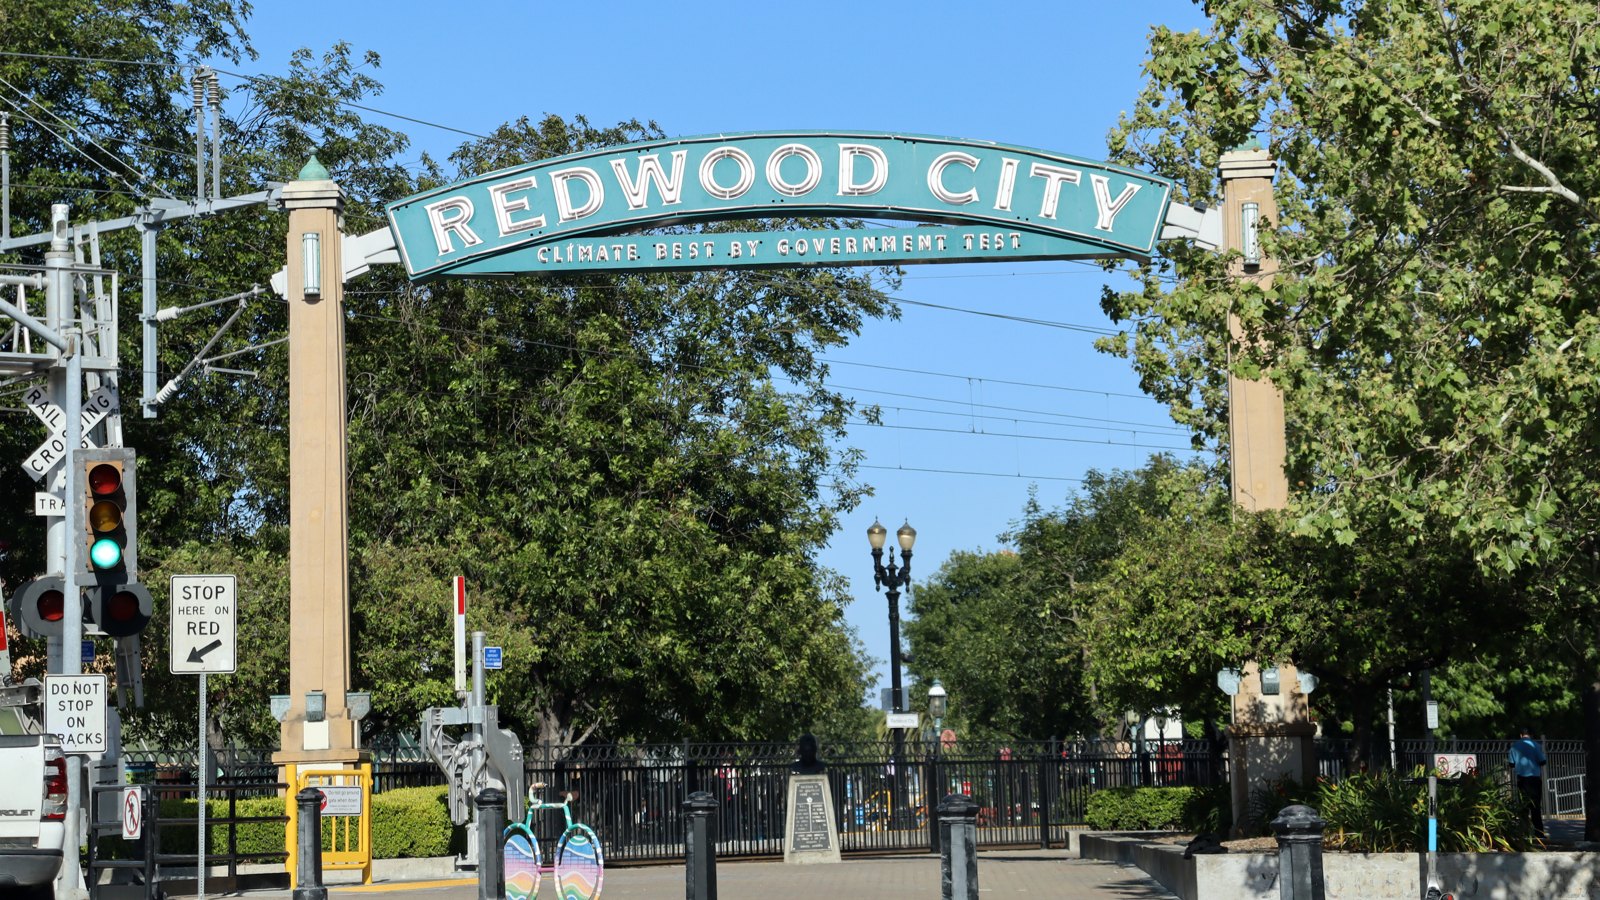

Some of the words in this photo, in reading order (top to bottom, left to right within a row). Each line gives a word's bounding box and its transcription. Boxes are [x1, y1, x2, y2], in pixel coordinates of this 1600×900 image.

[424, 143, 889, 256] REDWOOD
[927, 151, 1143, 233] CITY
[537, 243, 638, 263] CLIMATE
[656, 241, 715, 260] BEST
[730, 240, 759, 258] BY
[777, 234, 947, 256] GOVERNMENT
[963, 232, 1021, 250] TEST
[27, 389, 60, 428] RAIL
[31, 395, 110, 472] CROING
[40, 499, 66, 510] TRA
[182, 585, 226, 600] STOP
[178, 606, 206, 615] HERE
[214, 606, 229, 615] ON
[187, 621, 220, 635] RED
[51, 683, 70, 695] DO
[73, 683, 100, 695] NOT
[58, 700, 94, 712] STOP
[66, 716, 85, 728] ON
[58, 733, 103, 745] RACKS
